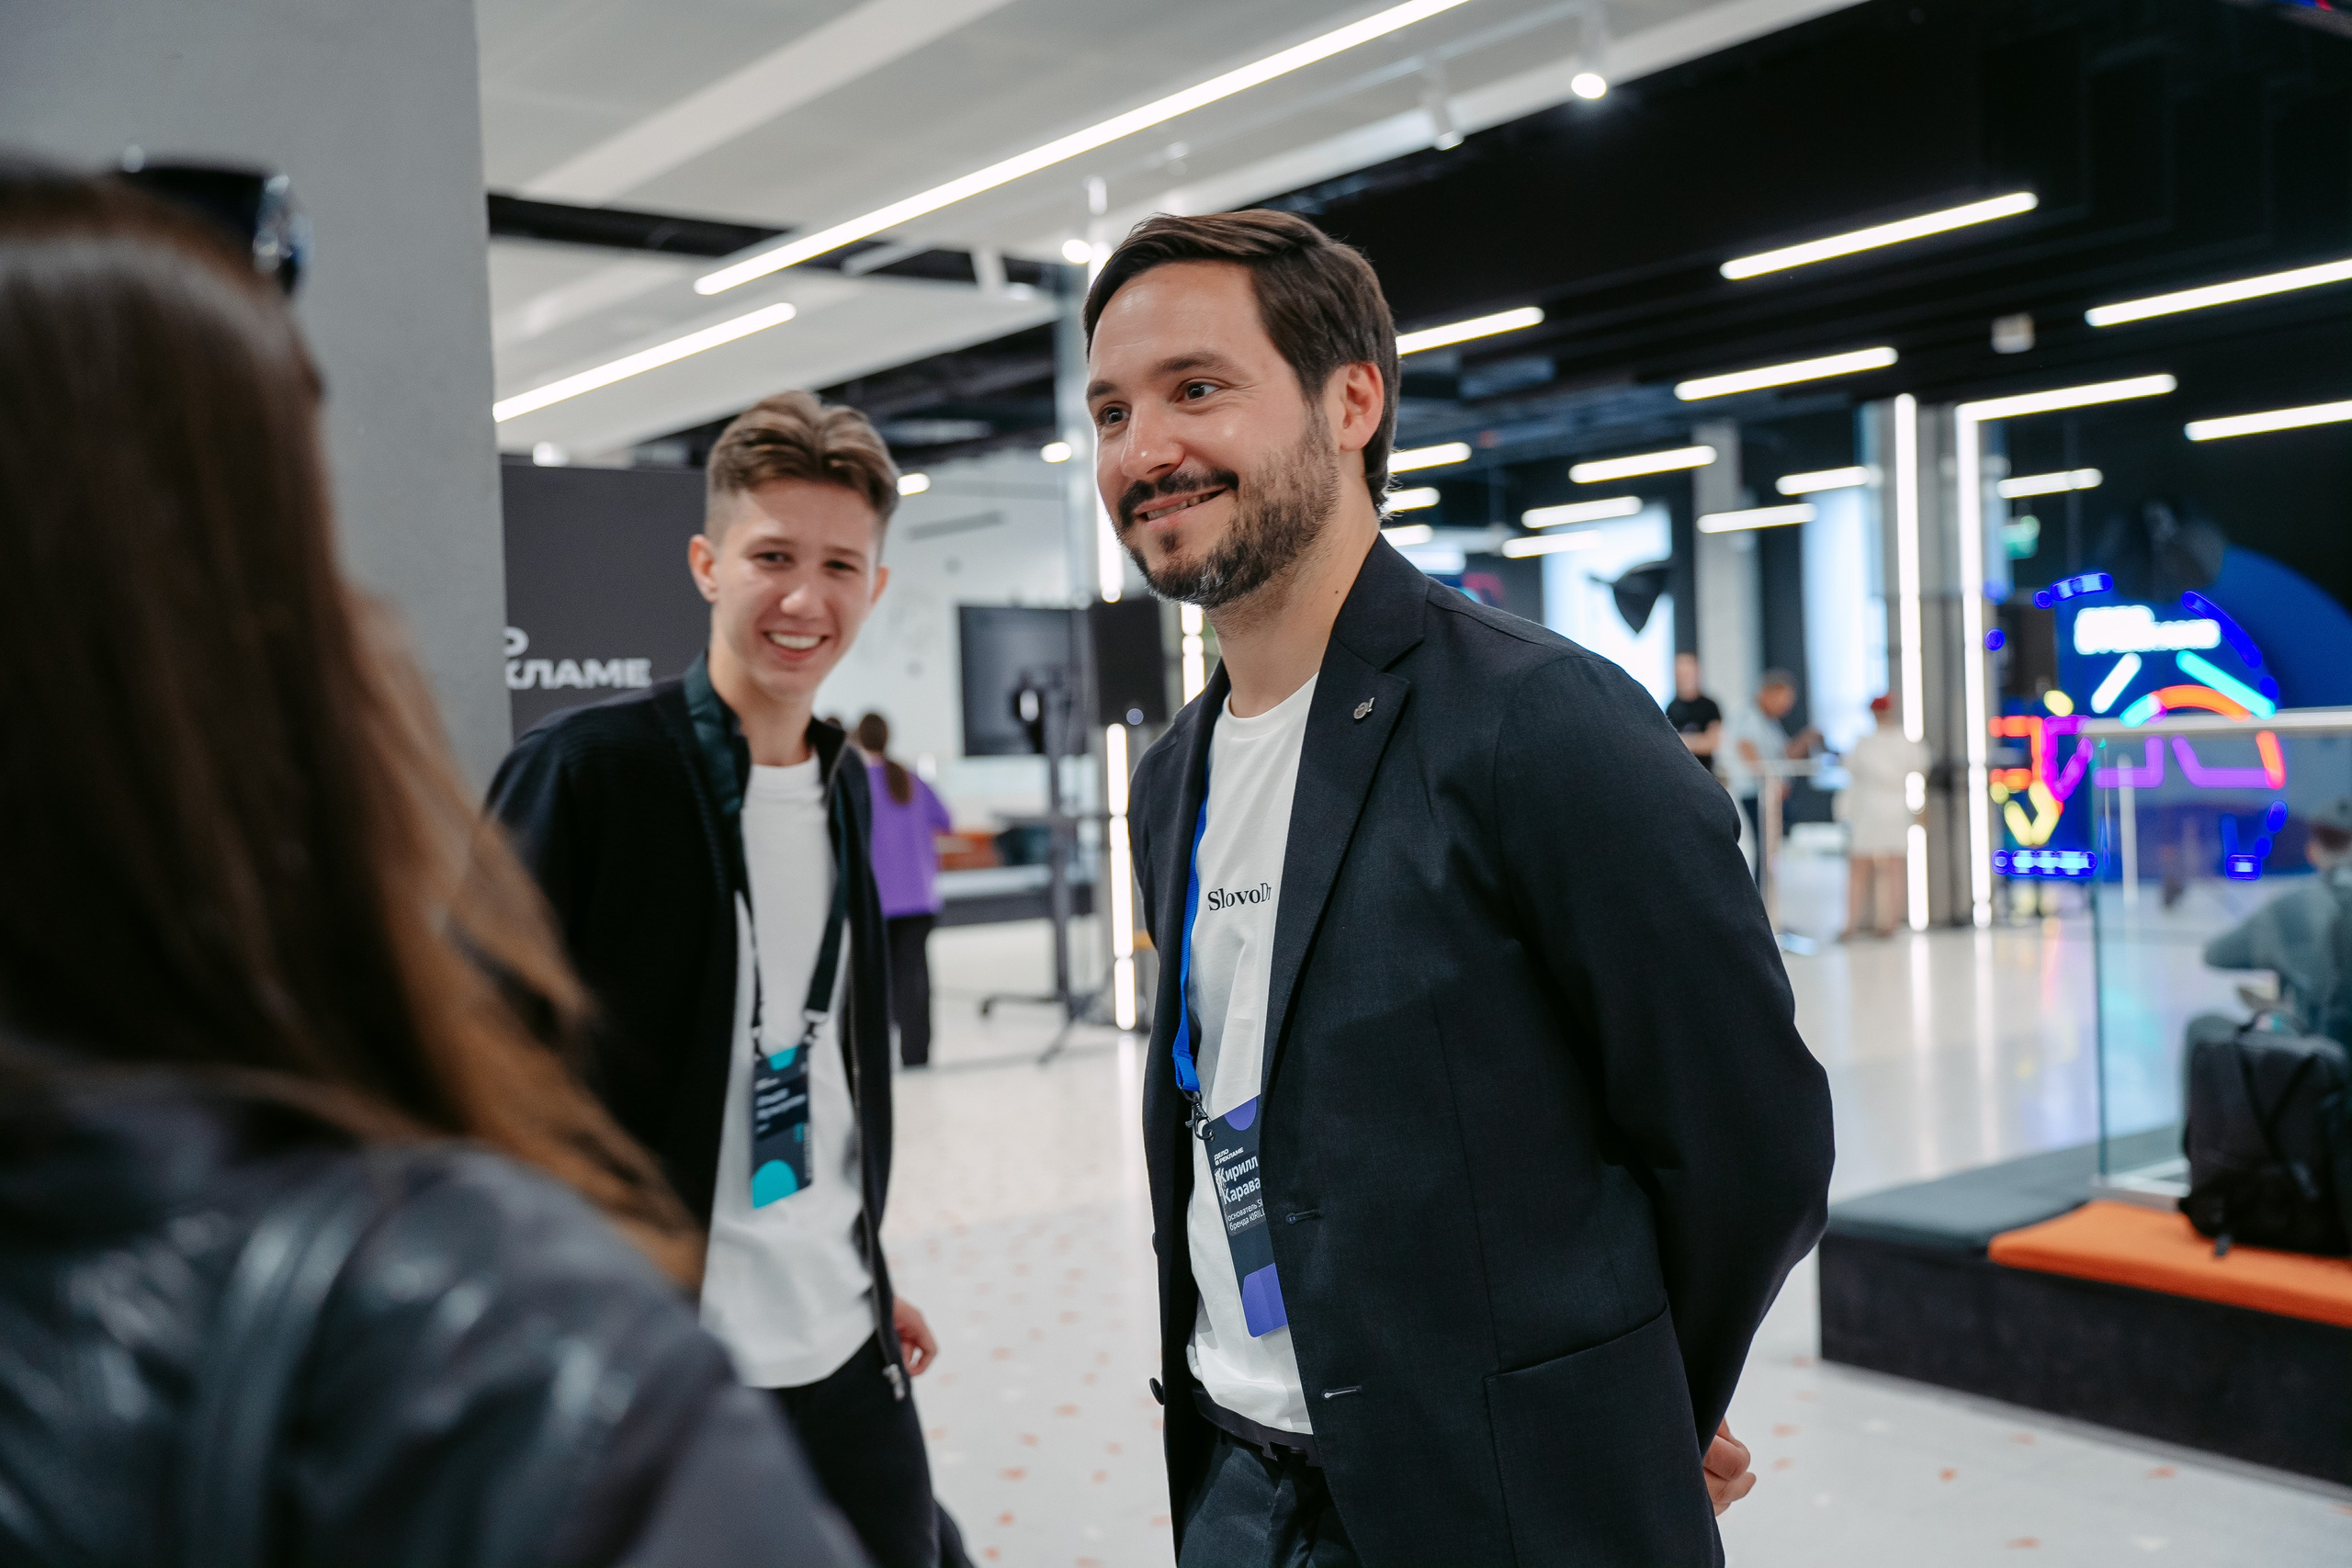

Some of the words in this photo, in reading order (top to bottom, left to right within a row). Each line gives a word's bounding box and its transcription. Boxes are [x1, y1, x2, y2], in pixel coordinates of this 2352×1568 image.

[1219, 1147, 1244, 1163] РЕКЛАМЕ
[1217, 1156, 1259, 1184] Кирилл
[1227, 1204, 1257, 1222] основатель
[1229, 1217, 1250, 1231] бренда
